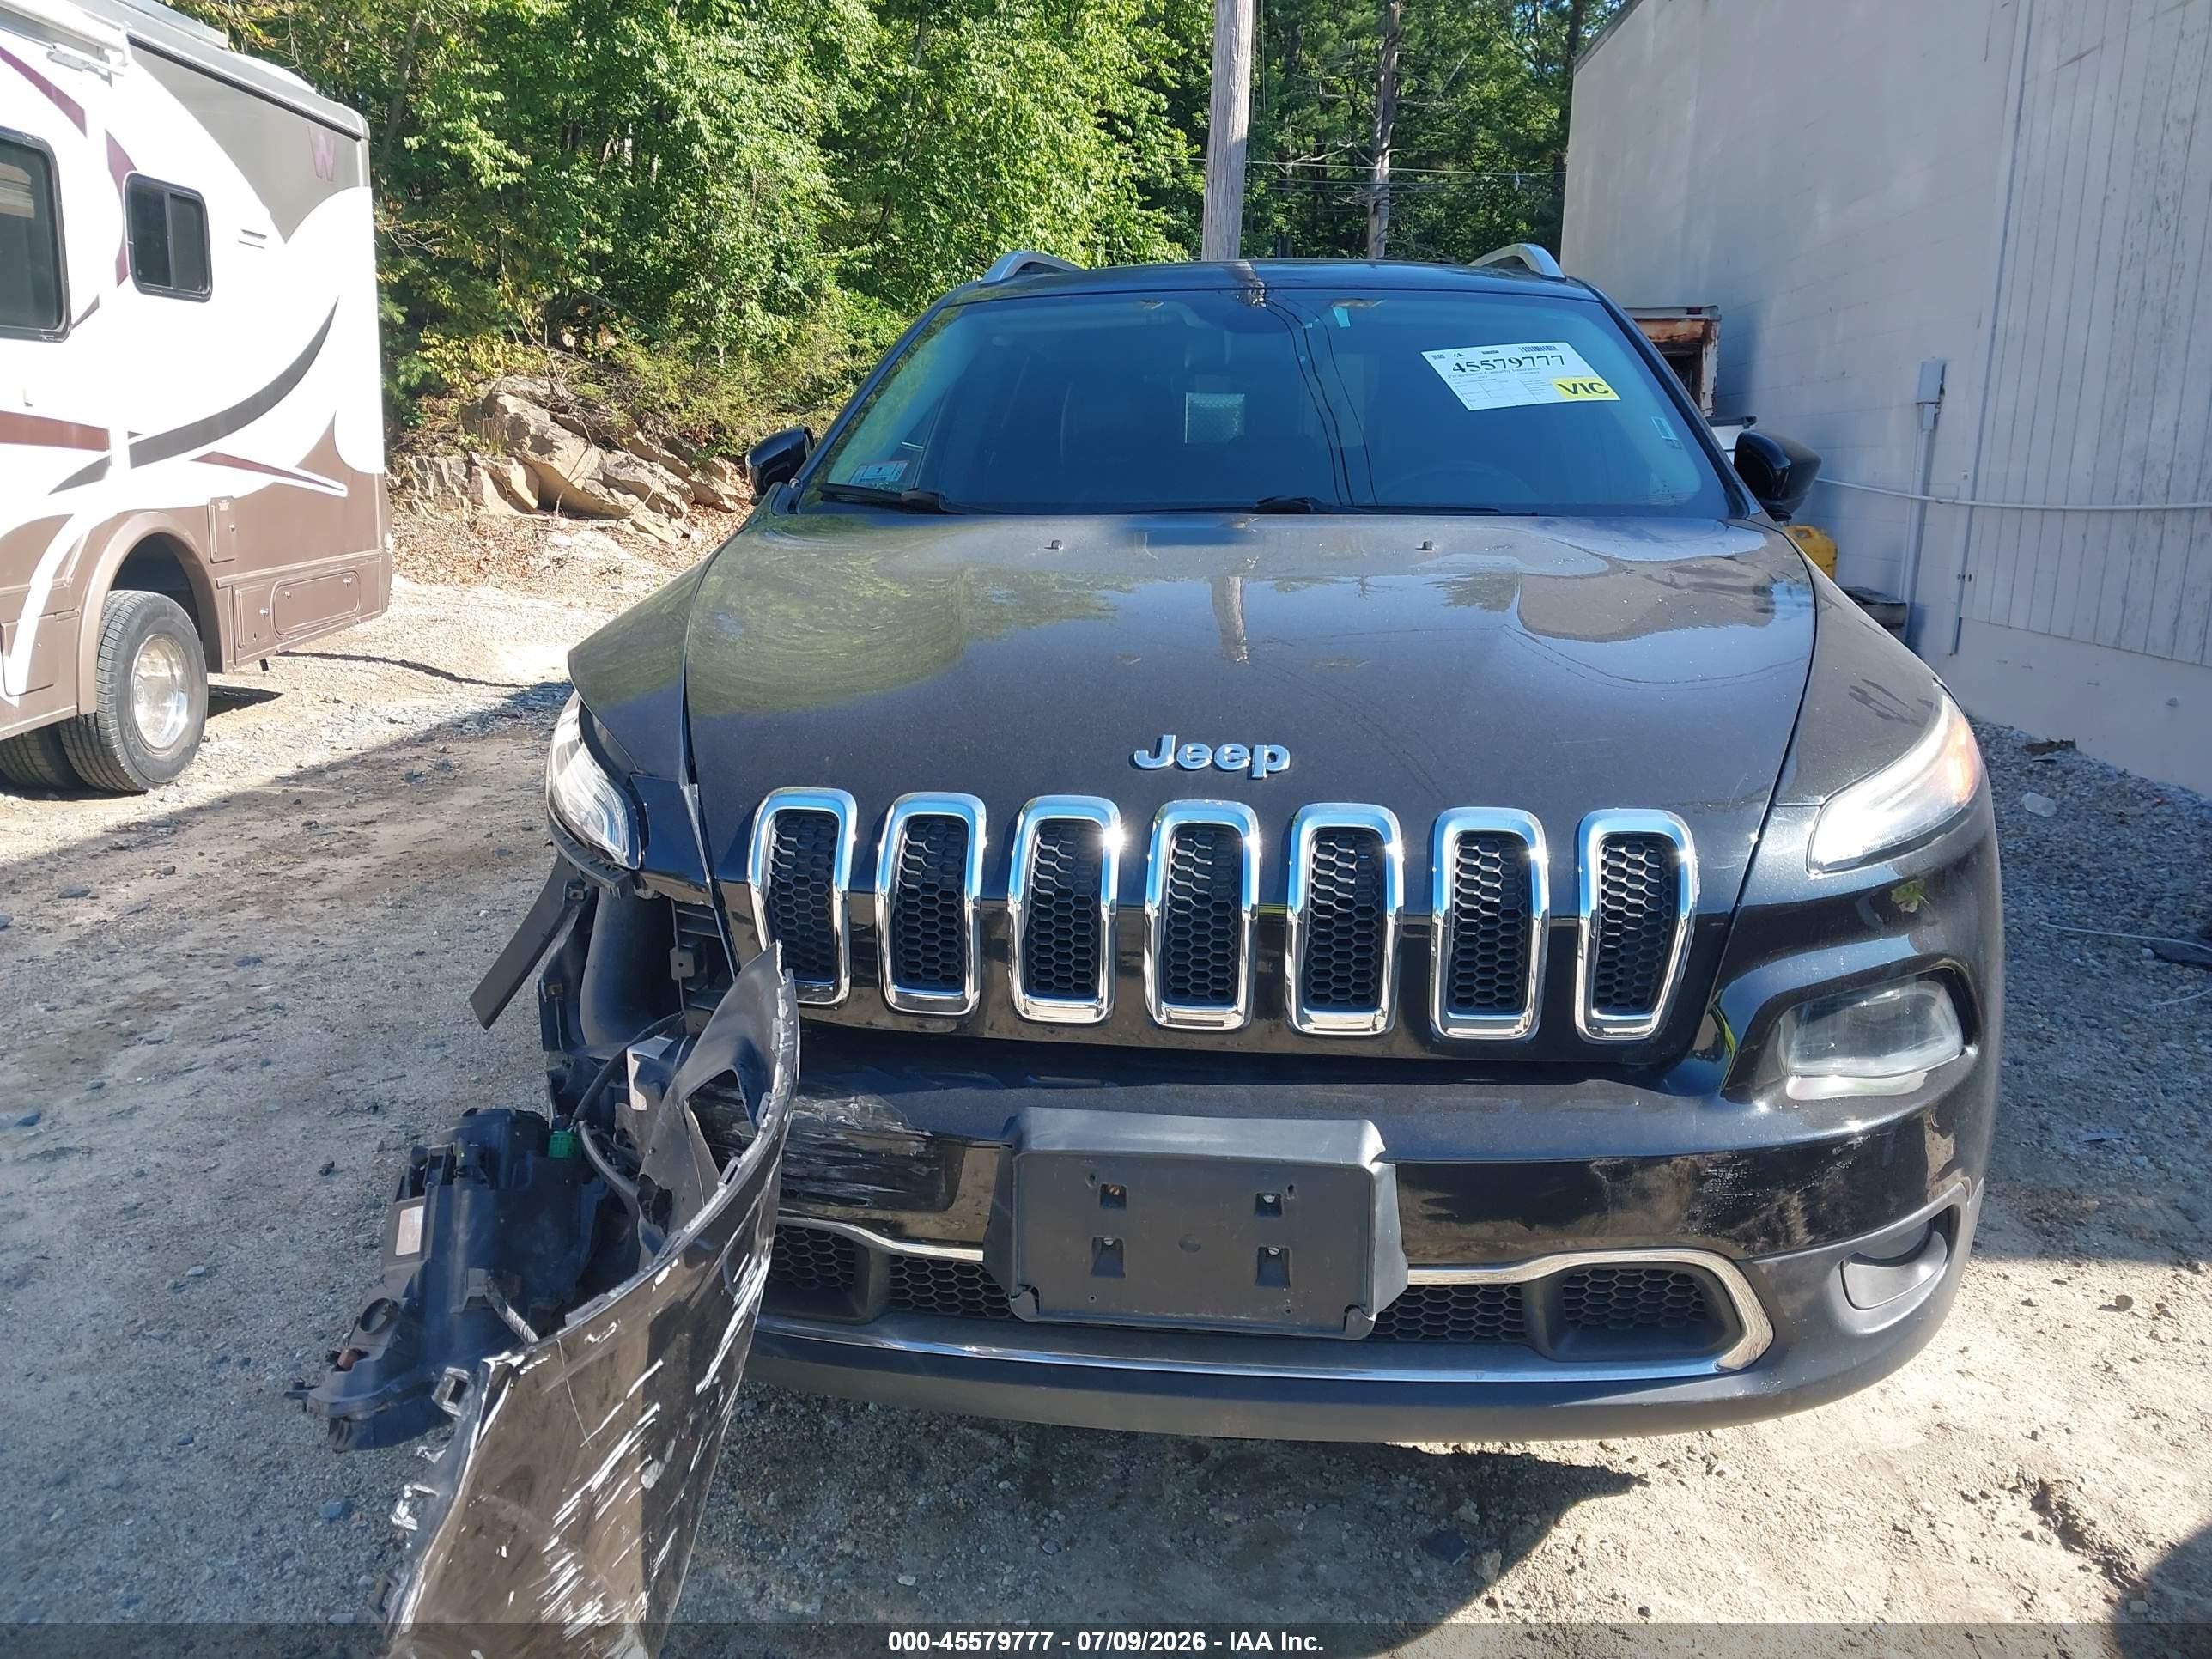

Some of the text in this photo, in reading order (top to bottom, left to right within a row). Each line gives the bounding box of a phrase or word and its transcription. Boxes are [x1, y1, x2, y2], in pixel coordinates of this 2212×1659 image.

[1453, 355, 1565, 373] 45579777
[1556, 382, 1609, 395] VIC
[1133, 734, 1291, 779] Jeep
